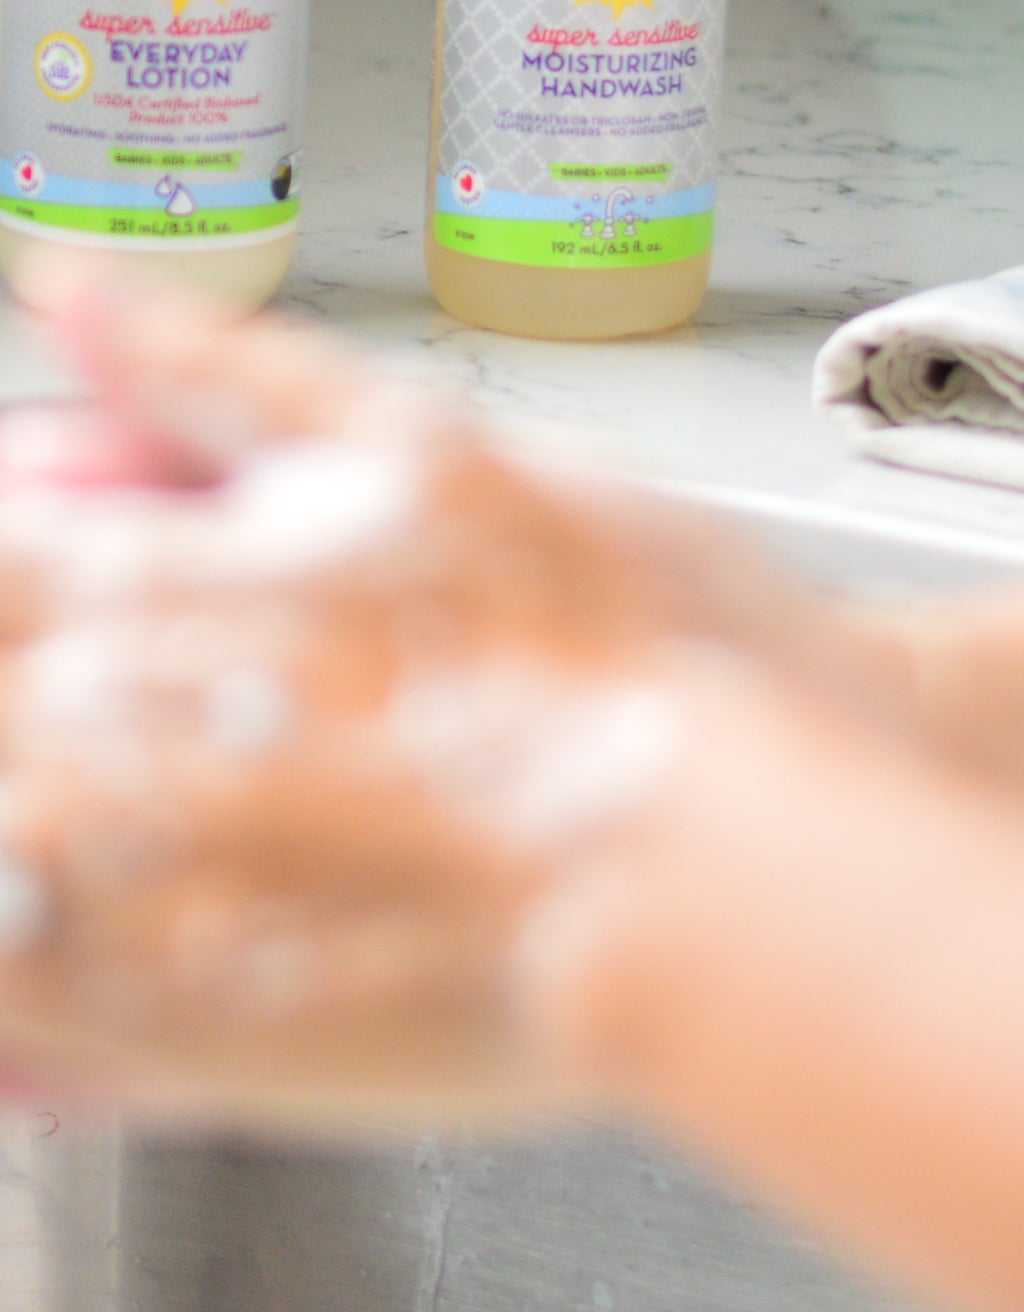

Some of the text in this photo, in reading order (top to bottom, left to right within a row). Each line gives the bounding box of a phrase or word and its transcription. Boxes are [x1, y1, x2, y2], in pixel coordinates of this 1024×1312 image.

[79, 7, 272, 43] super sensitive
[525, 19, 698, 54] super sensitive
[109, 40, 248, 65] EVERYDAY
[521, 47, 697, 75] MOISTURIZING
[126, 66, 231, 89] LOTION
[540, 74, 683, 99] HANDWASH
[108, 218, 135, 234] 251
[551, 241, 575, 255] 192
